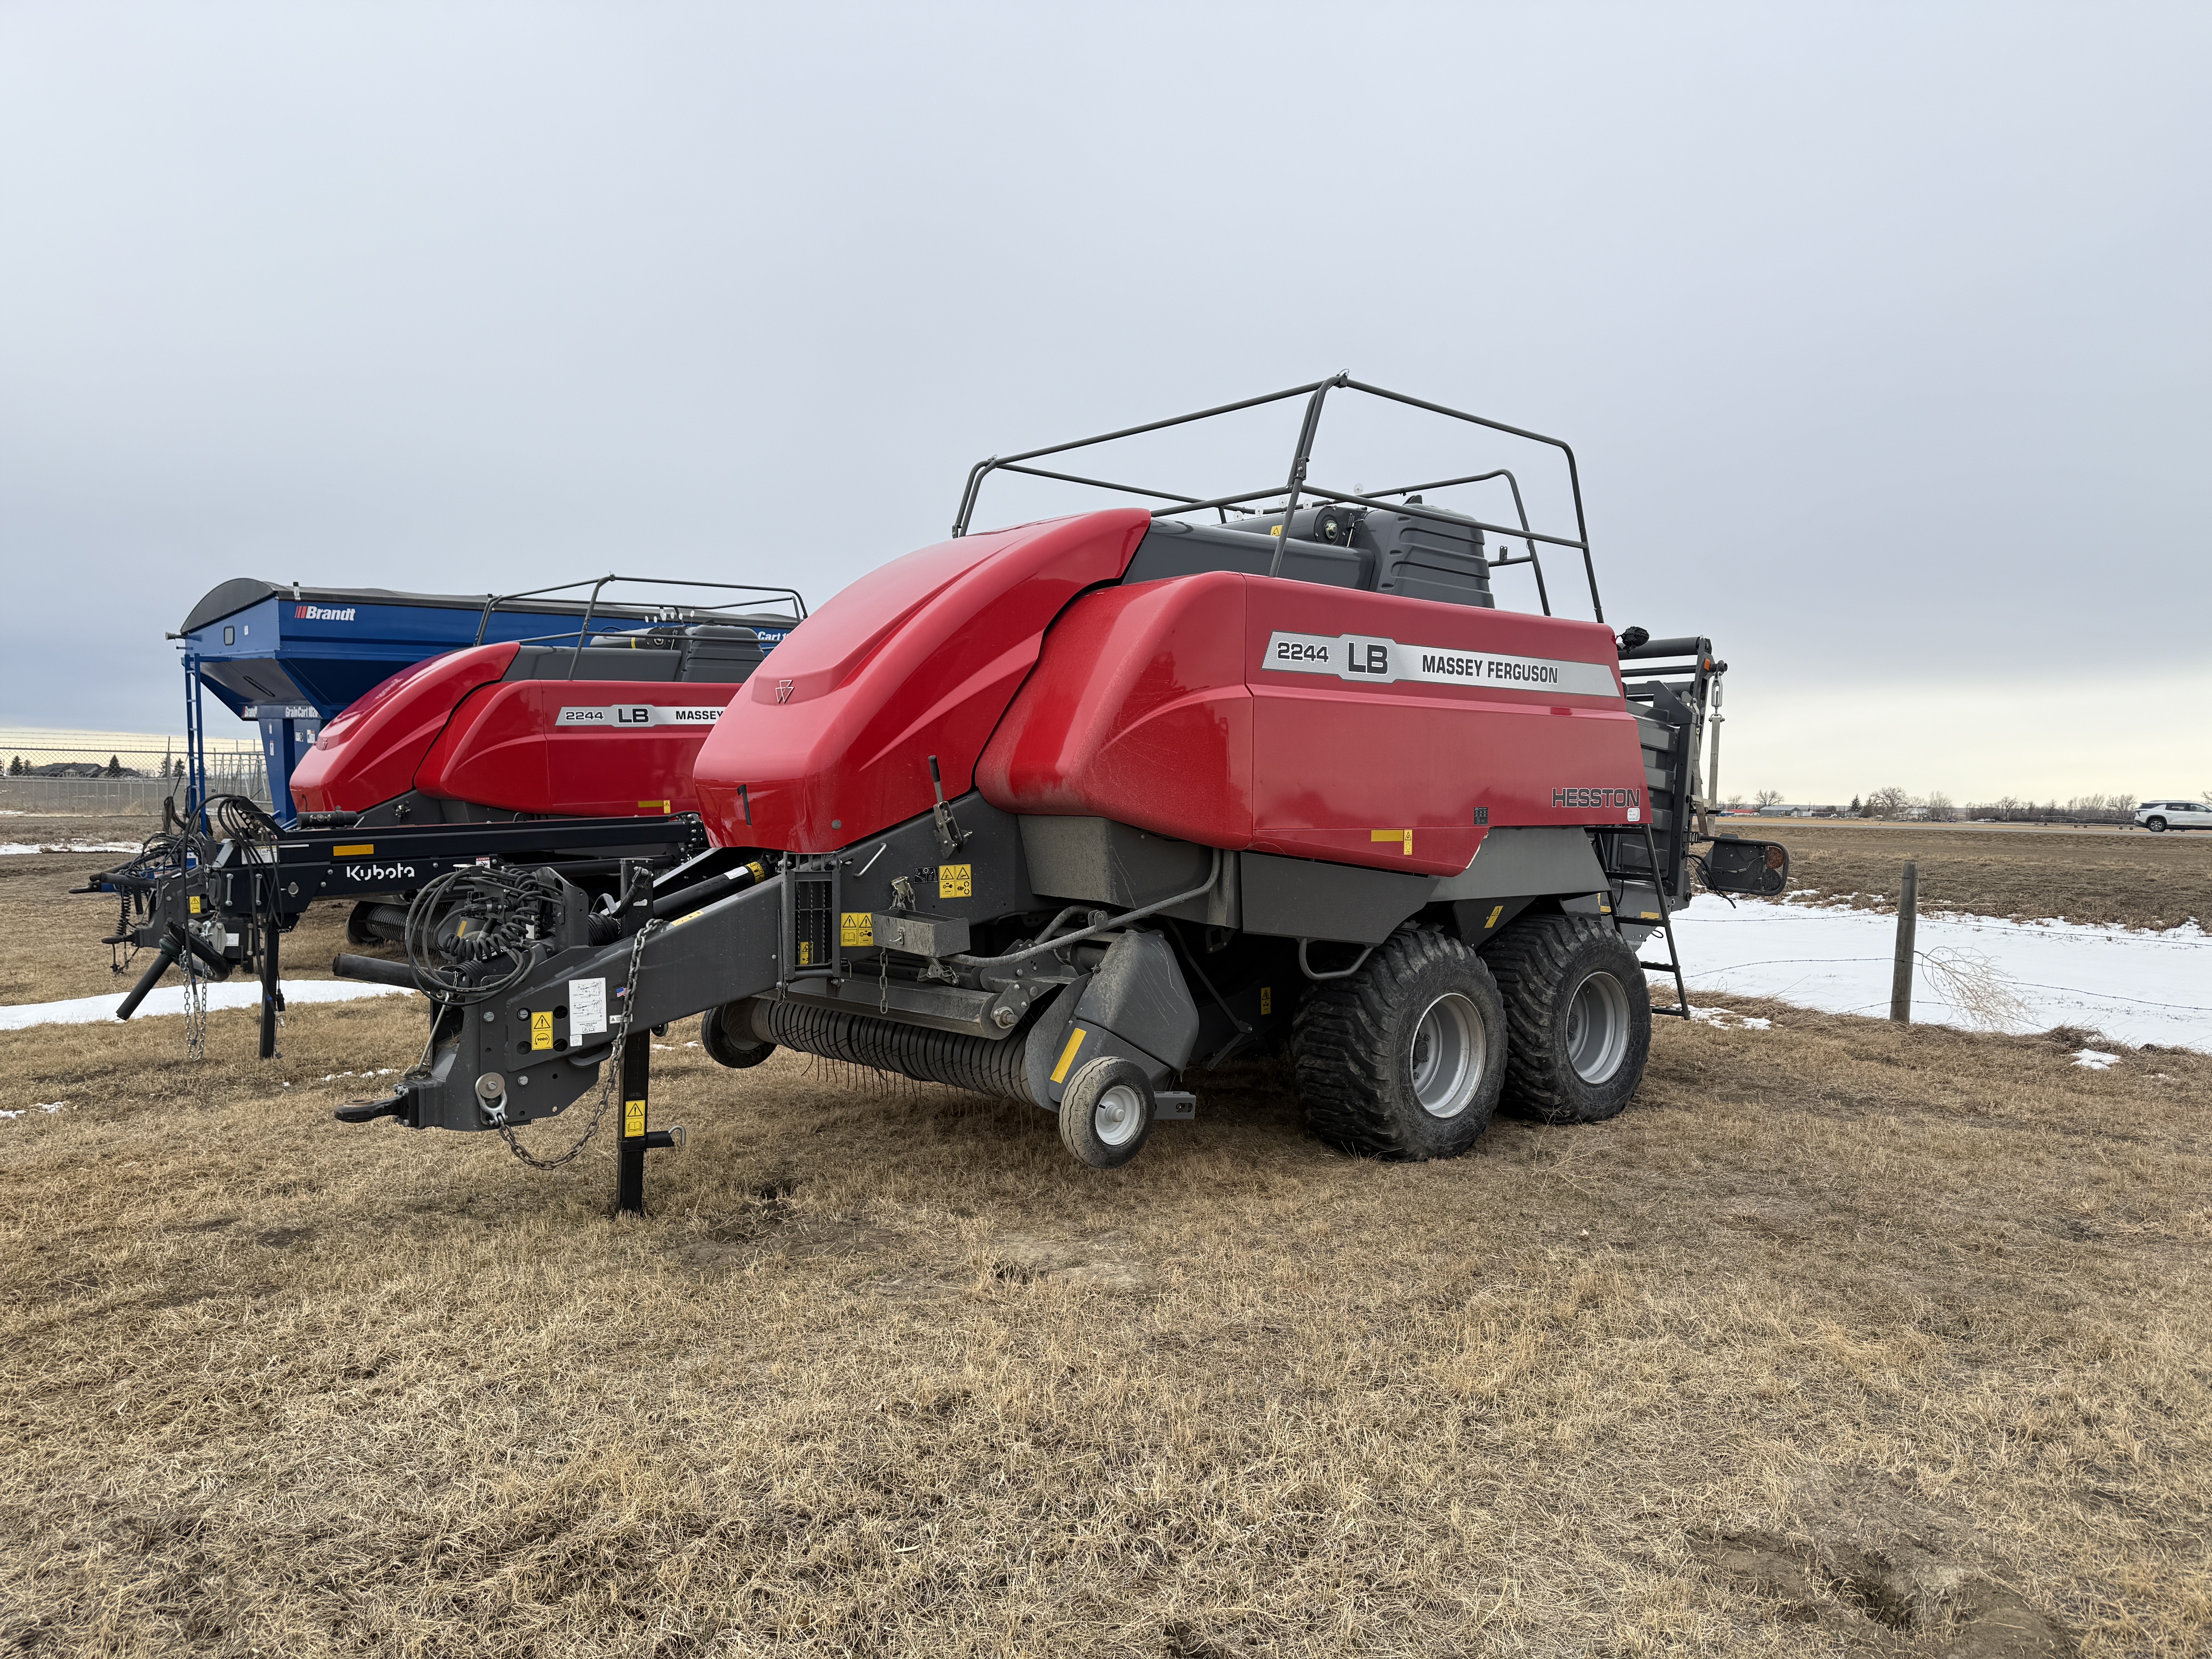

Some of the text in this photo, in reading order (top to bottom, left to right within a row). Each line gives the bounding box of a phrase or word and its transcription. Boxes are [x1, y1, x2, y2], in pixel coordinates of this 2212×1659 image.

[306, 606, 356, 621] Brandt
[758, 631, 781, 641] Cart
[1278, 642, 1388, 674] 2244 LB
[1422, 654, 1558, 684] MASSEY FERGUSON
[618, 708, 649, 723] LB
[1552, 788, 1640, 807] HESSTON
[346, 863, 415, 881] Kubota
